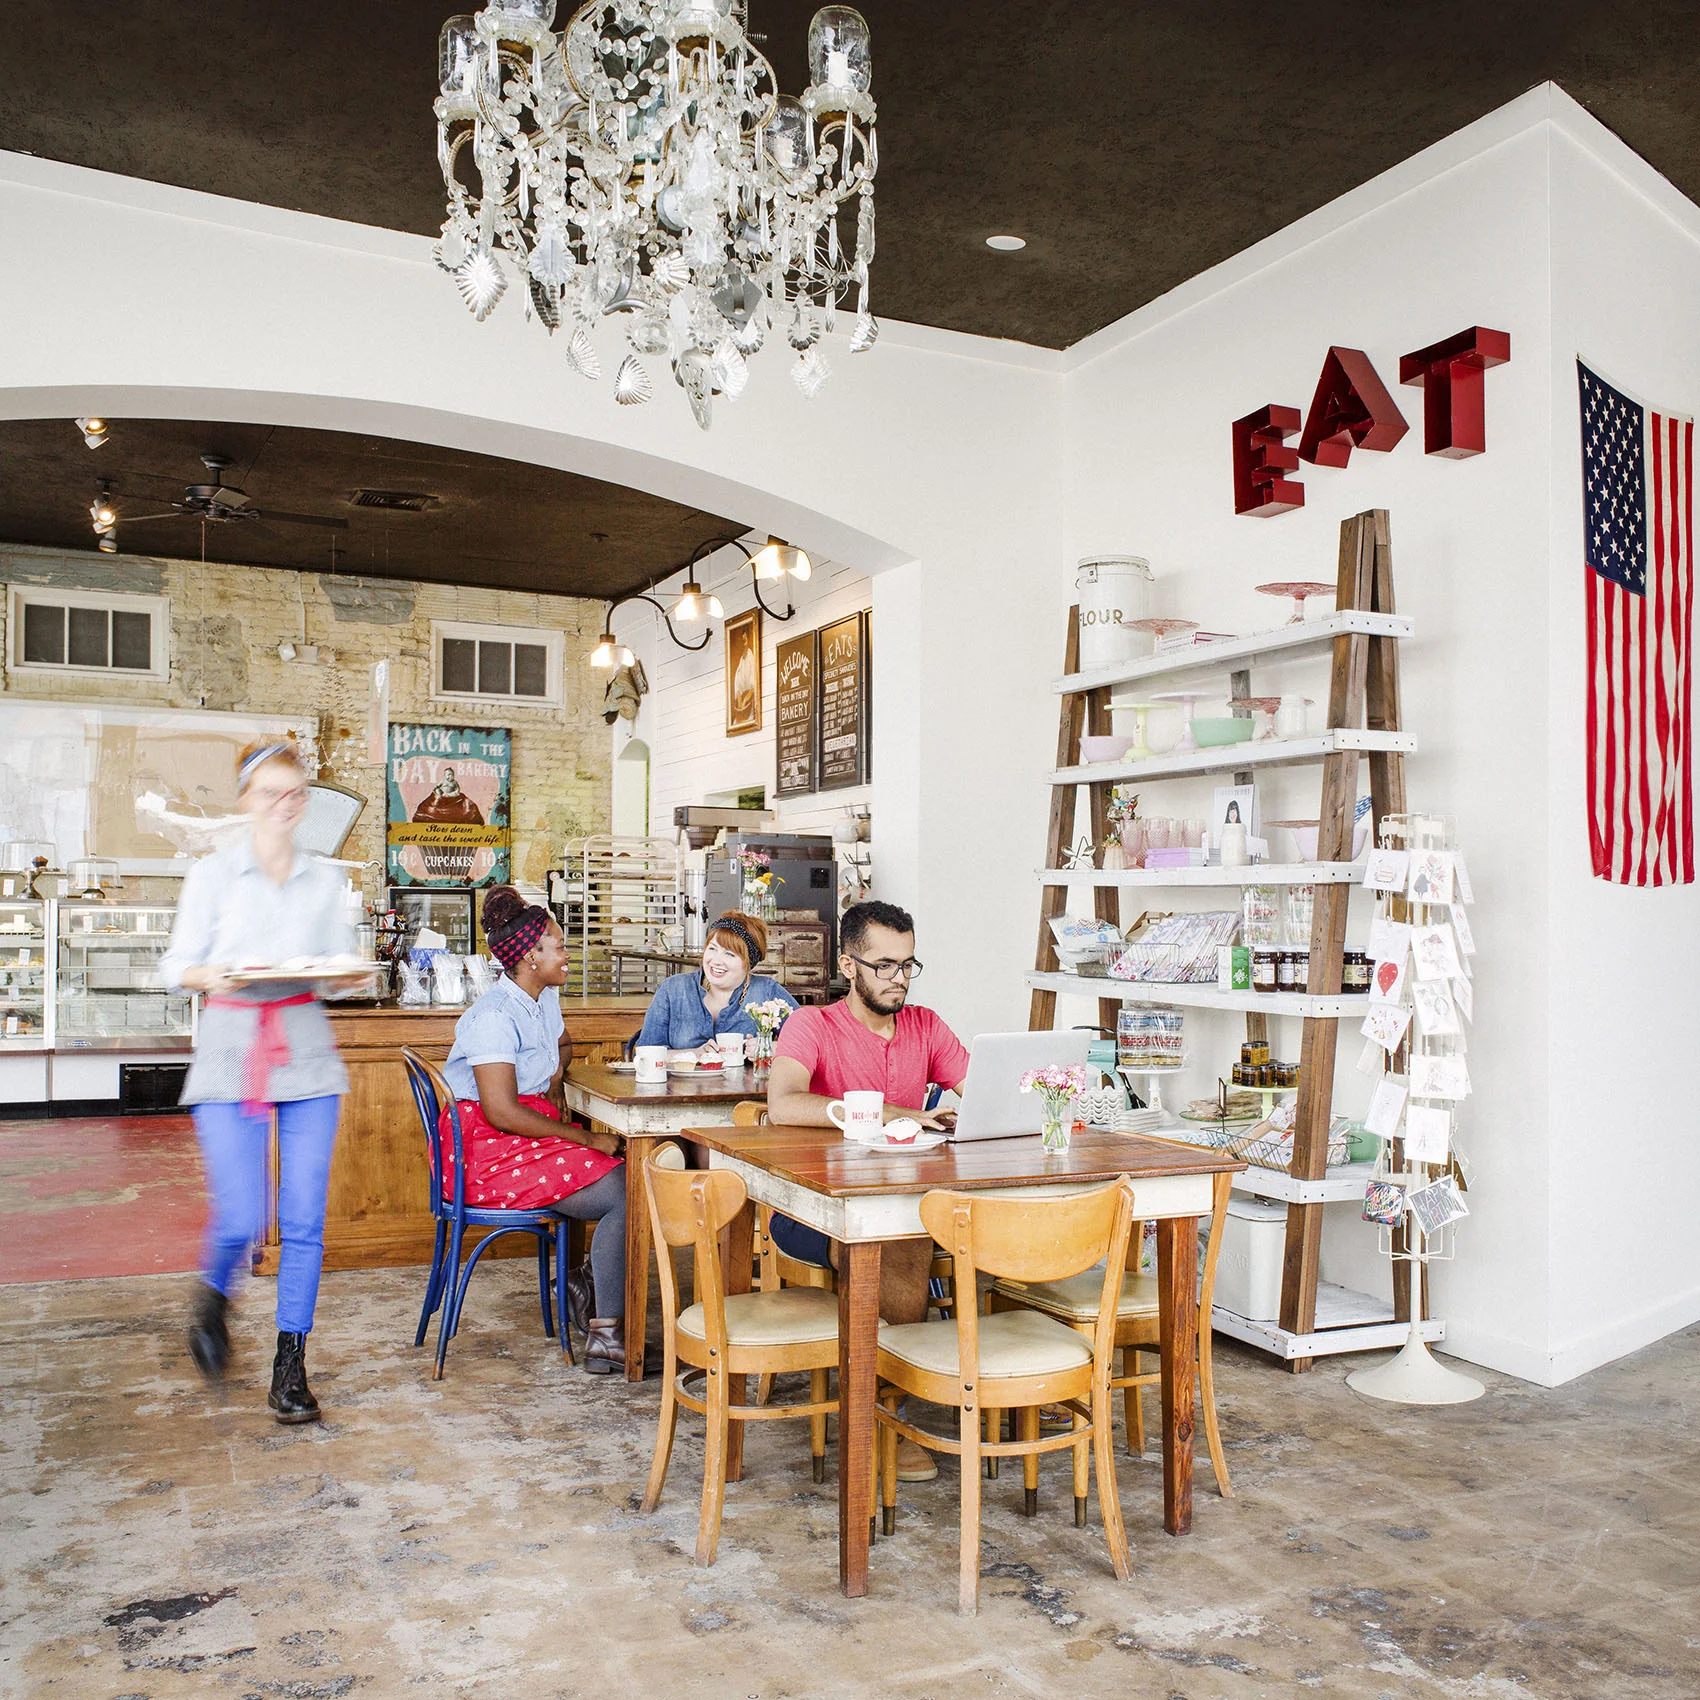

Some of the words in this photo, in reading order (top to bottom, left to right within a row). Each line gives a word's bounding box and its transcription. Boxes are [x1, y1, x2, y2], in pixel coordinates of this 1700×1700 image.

[1232, 326, 1510, 518] EAT
[828, 634, 853, 665] EATS
[781, 651, 810, 685] WELCOME
[781, 701, 809, 721] BAKERY
[393, 724, 454, 755] BACK
[458, 742, 470, 754] IN
[480, 743, 505, 757] THE
[392, 758, 441, 784] DAY
[457, 762, 508, 778] BAKERY
[398, 834, 416, 842] and
[419, 834, 441, 842] taste
[443, 834, 457, 843] the
[426, 824, 448, 833] Slow
[450, 825, 473, 834] down
[425, 855, 475, 868] CUPCAKES
